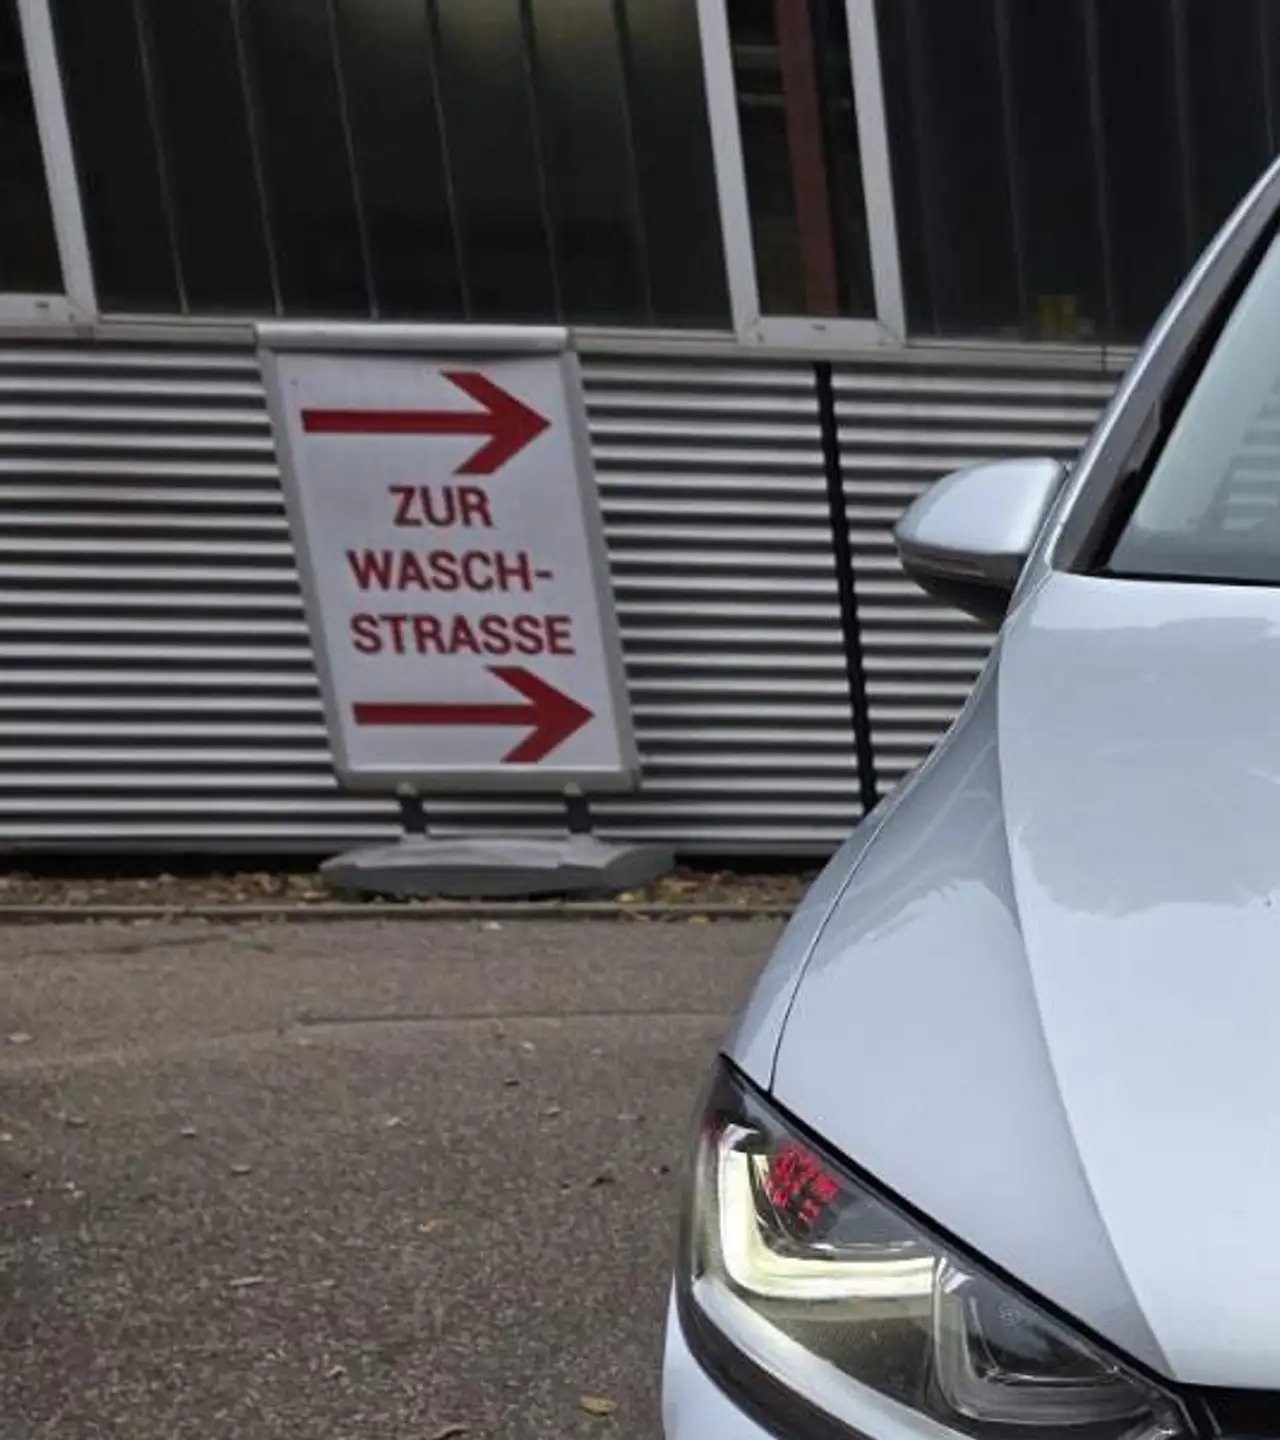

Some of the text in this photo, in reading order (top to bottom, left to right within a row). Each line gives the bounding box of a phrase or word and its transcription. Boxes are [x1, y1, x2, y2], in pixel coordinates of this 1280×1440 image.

[387, 483, 494, 529] ZUR
[345, 548, 554, 593] WASCH-
[349, 612, 577, 656] STRASSE
